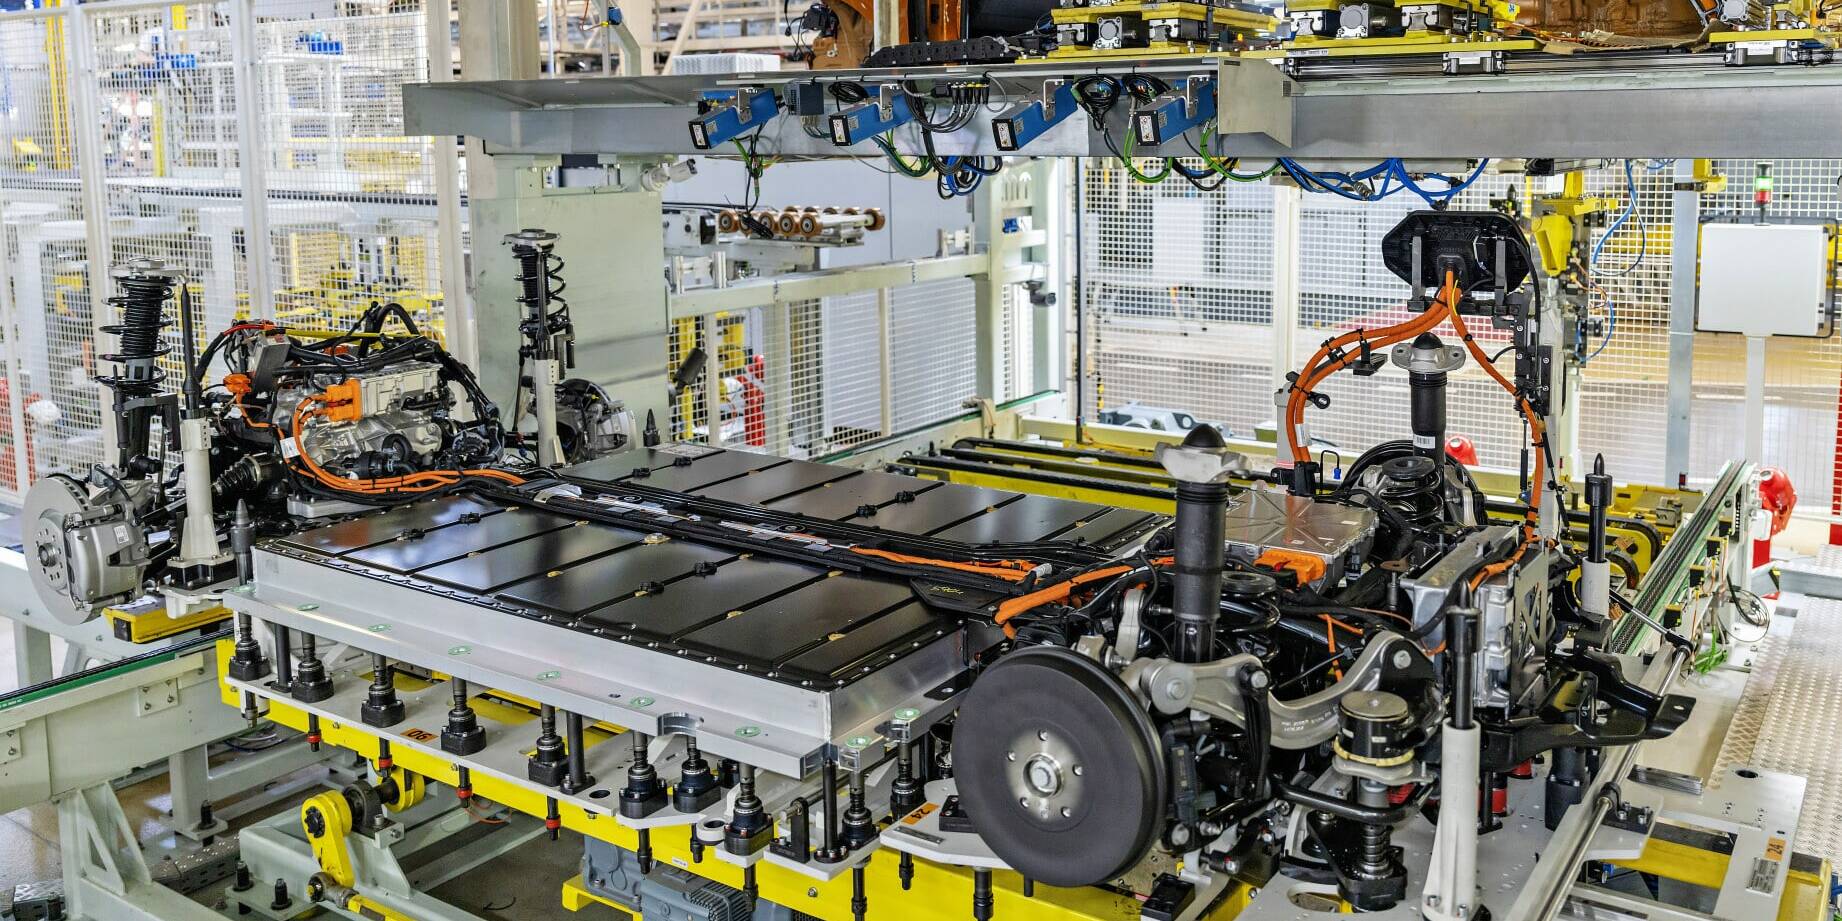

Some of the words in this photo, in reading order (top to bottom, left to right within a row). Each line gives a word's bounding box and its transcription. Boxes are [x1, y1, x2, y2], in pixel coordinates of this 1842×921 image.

[408, 730, 432, 740] 06
[910, 808, 930, 819] 24
[1767, 843, 1783, 855] 24
